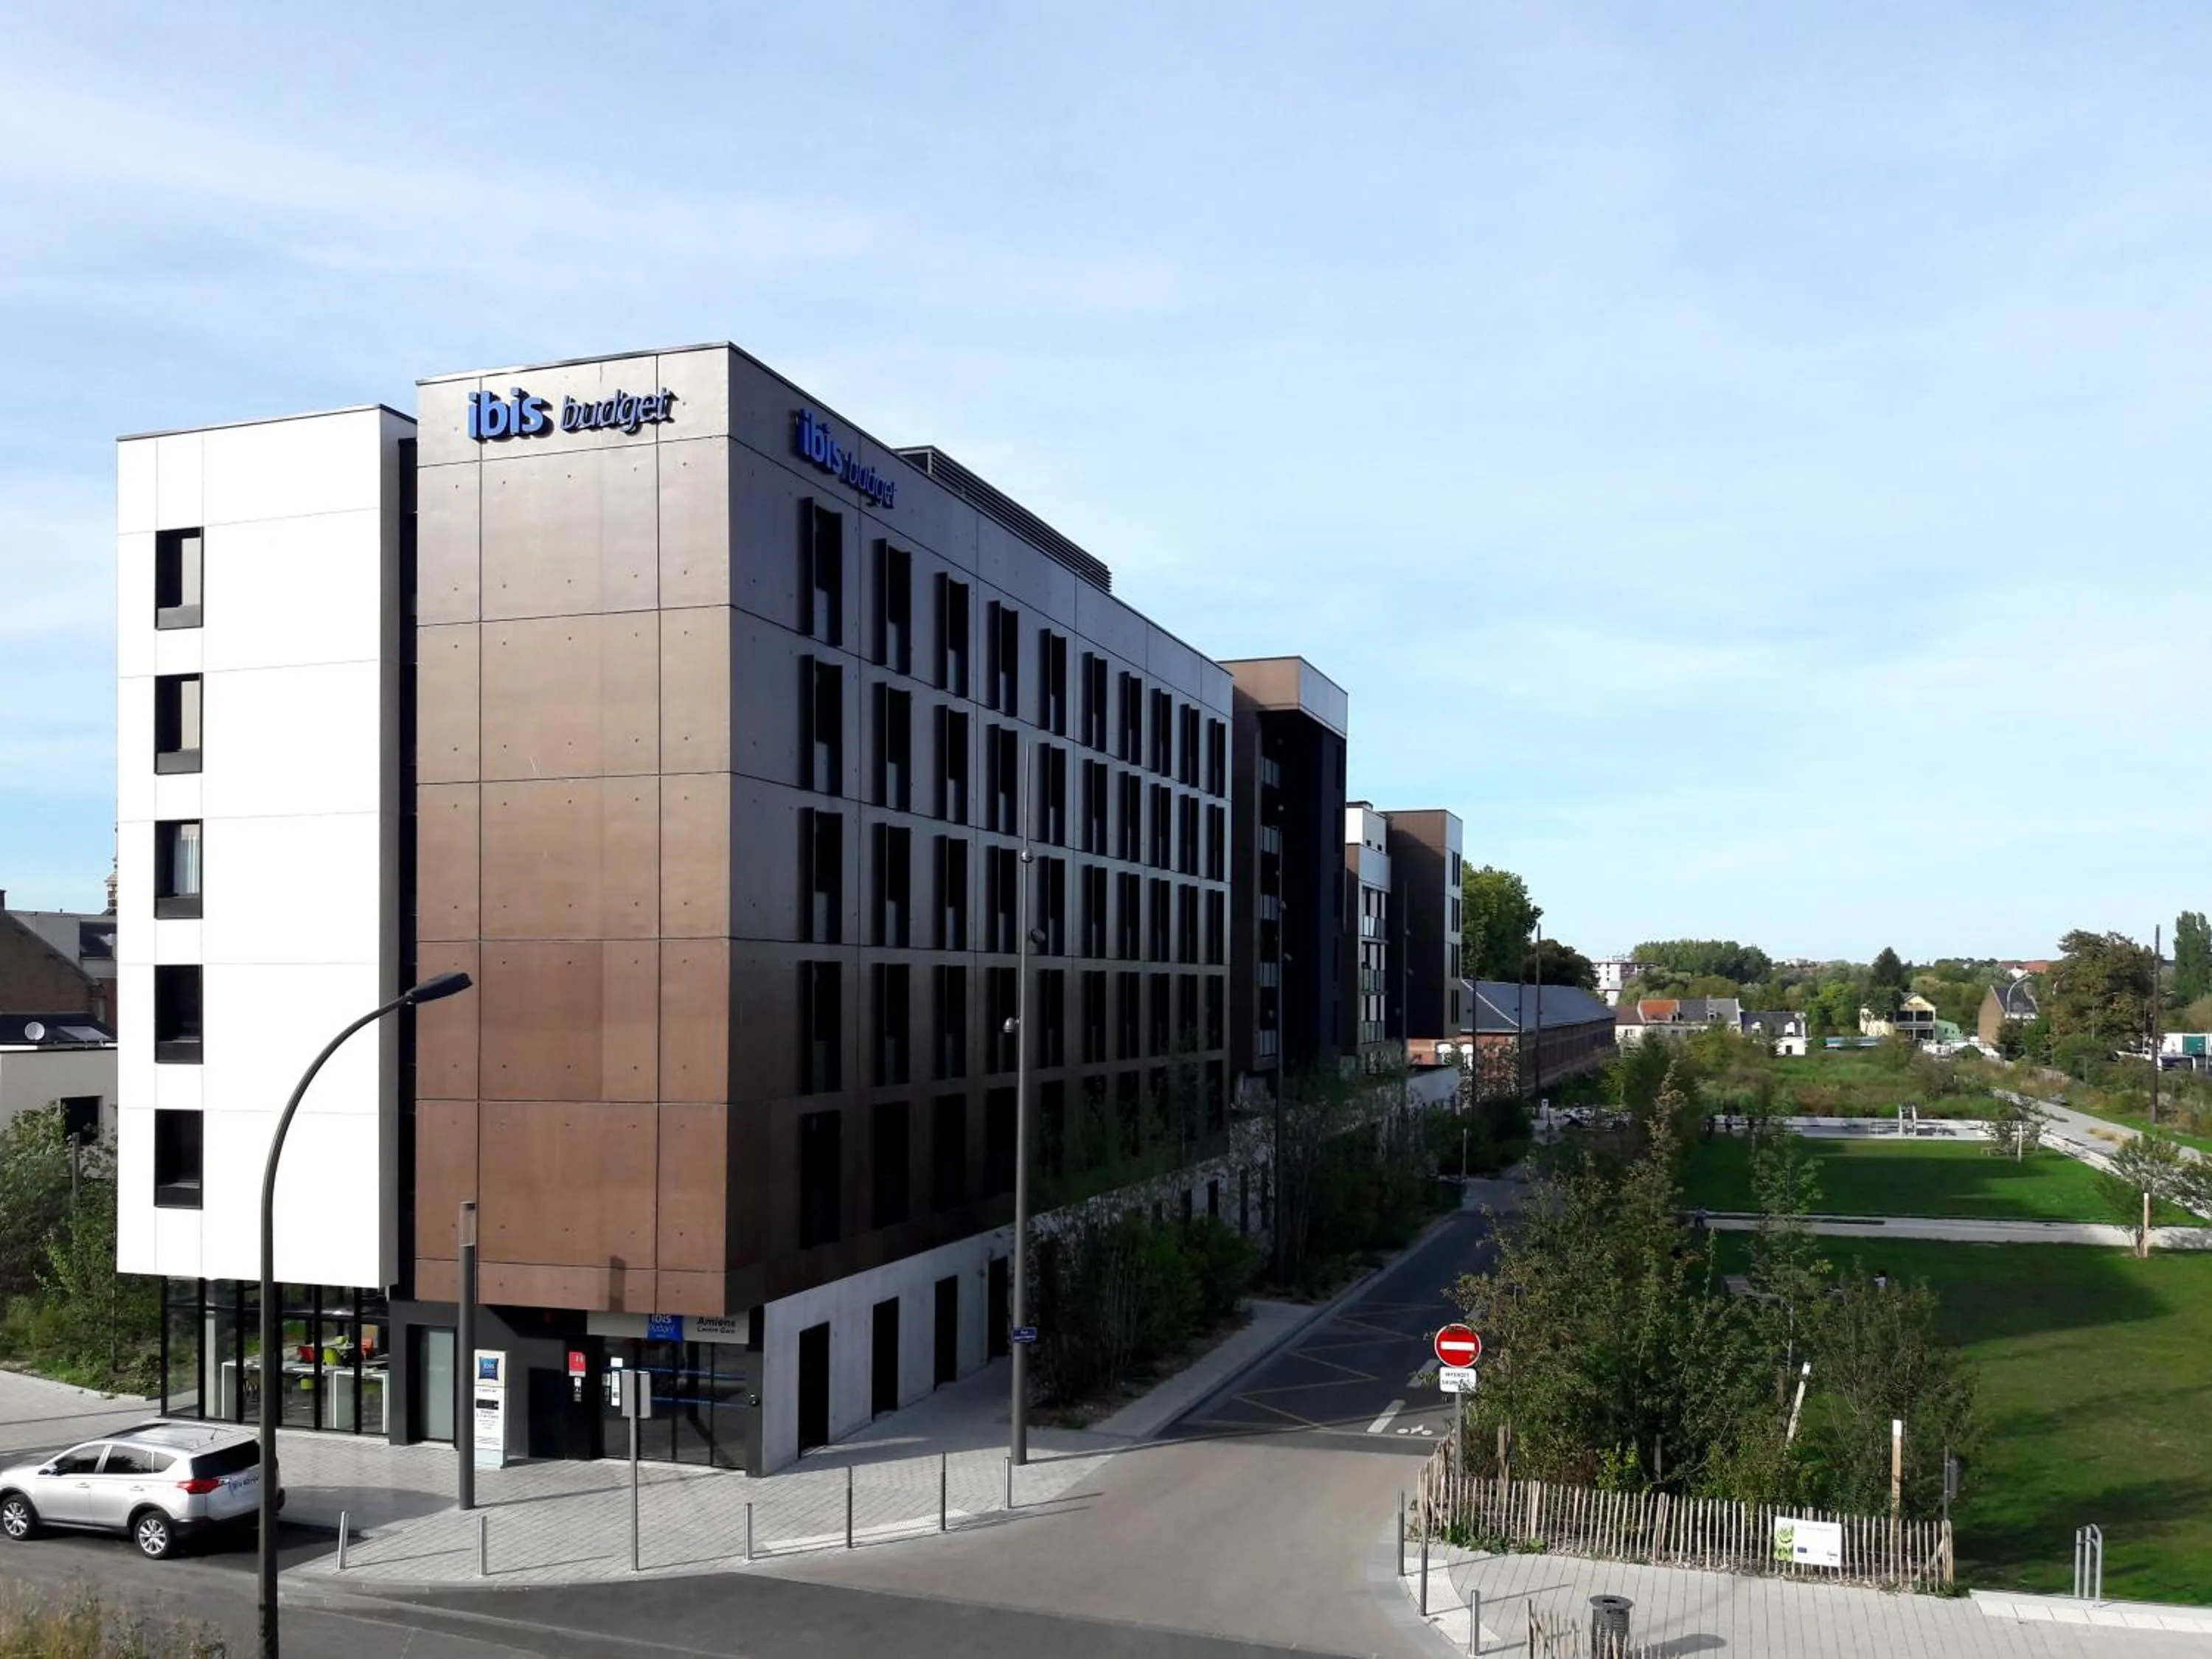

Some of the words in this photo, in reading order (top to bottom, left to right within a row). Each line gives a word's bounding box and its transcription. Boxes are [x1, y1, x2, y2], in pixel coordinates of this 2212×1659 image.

[467, 386, 549, 441] ibis
[560, 387, 677, 435] budget
[799, 408, 844, 474] ibis
[845, 451, 897, 509] budget
